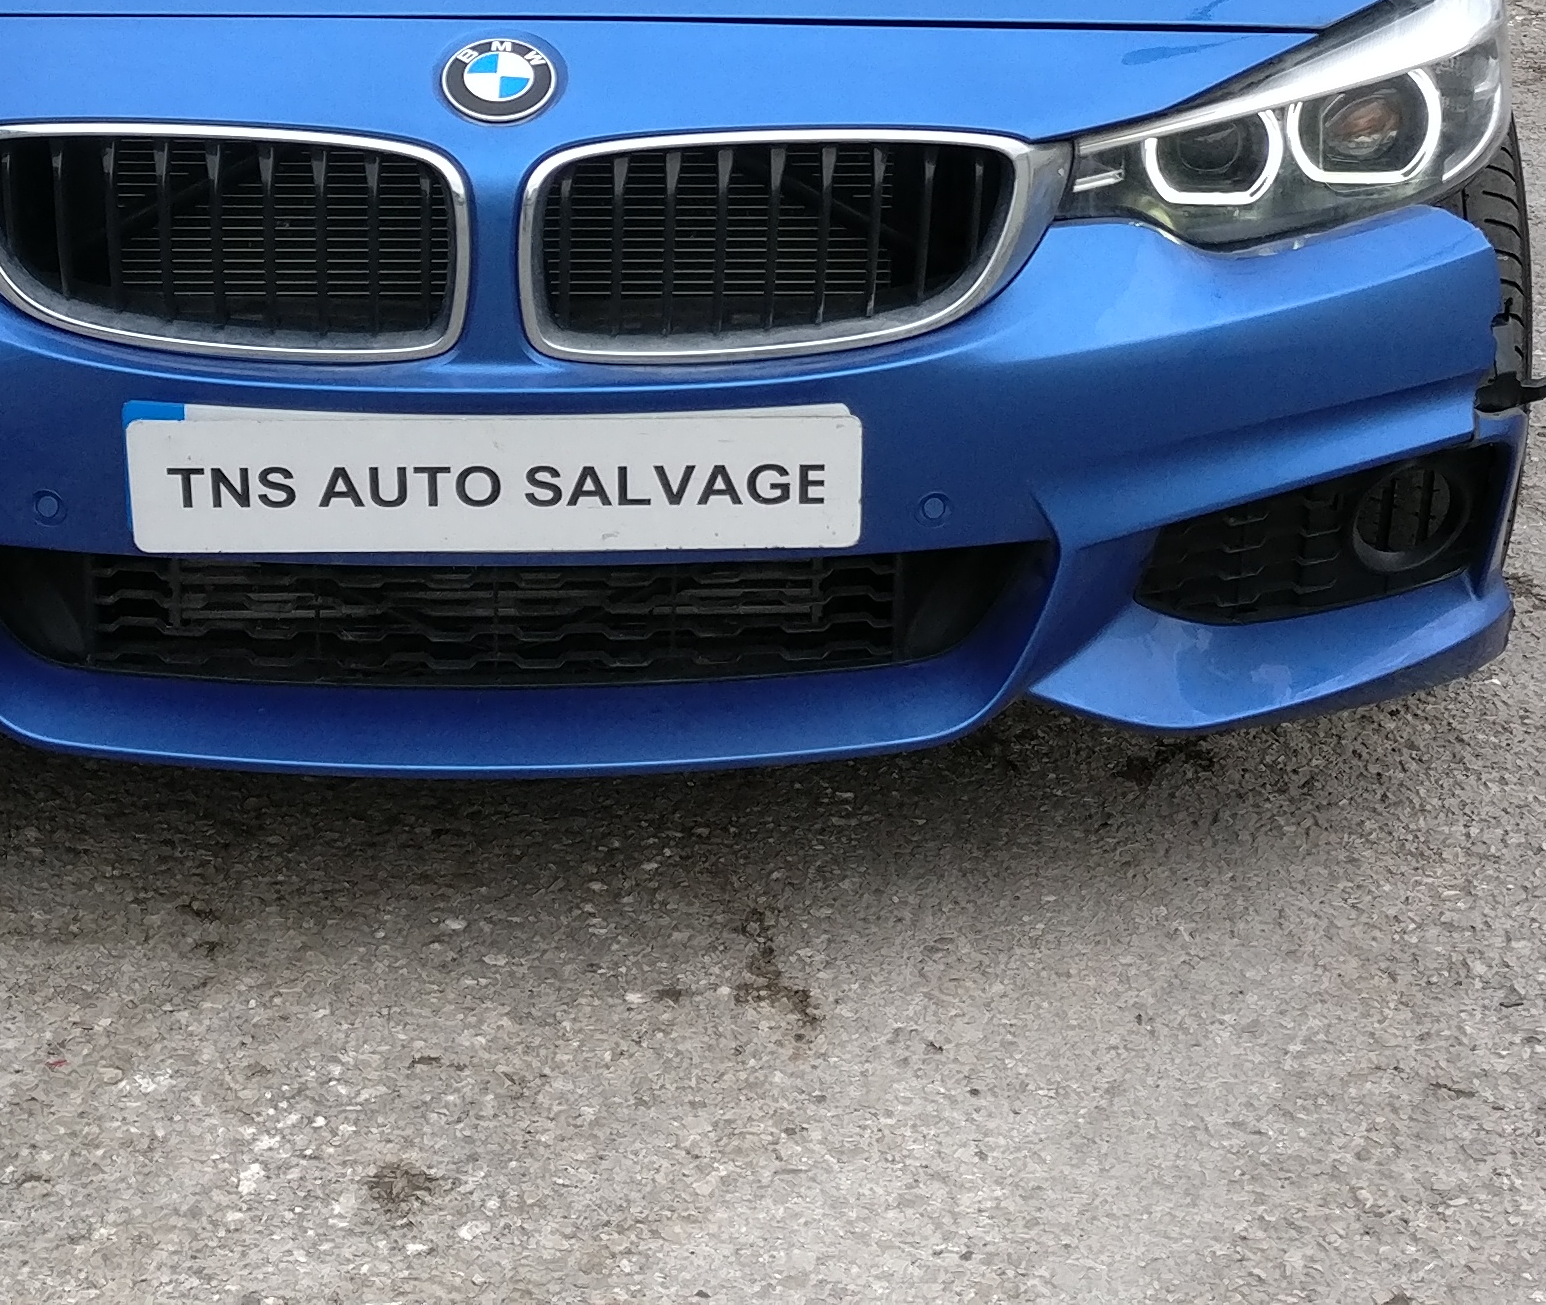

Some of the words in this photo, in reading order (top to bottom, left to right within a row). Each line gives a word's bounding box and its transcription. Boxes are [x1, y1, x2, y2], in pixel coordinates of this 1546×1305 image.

[456, 40, 547, 66] BMW
[166, 466, 297, 509] TNS
[319, 465, 502, 508] AUTO
[525, 463, 825, 507] SALVAGE
